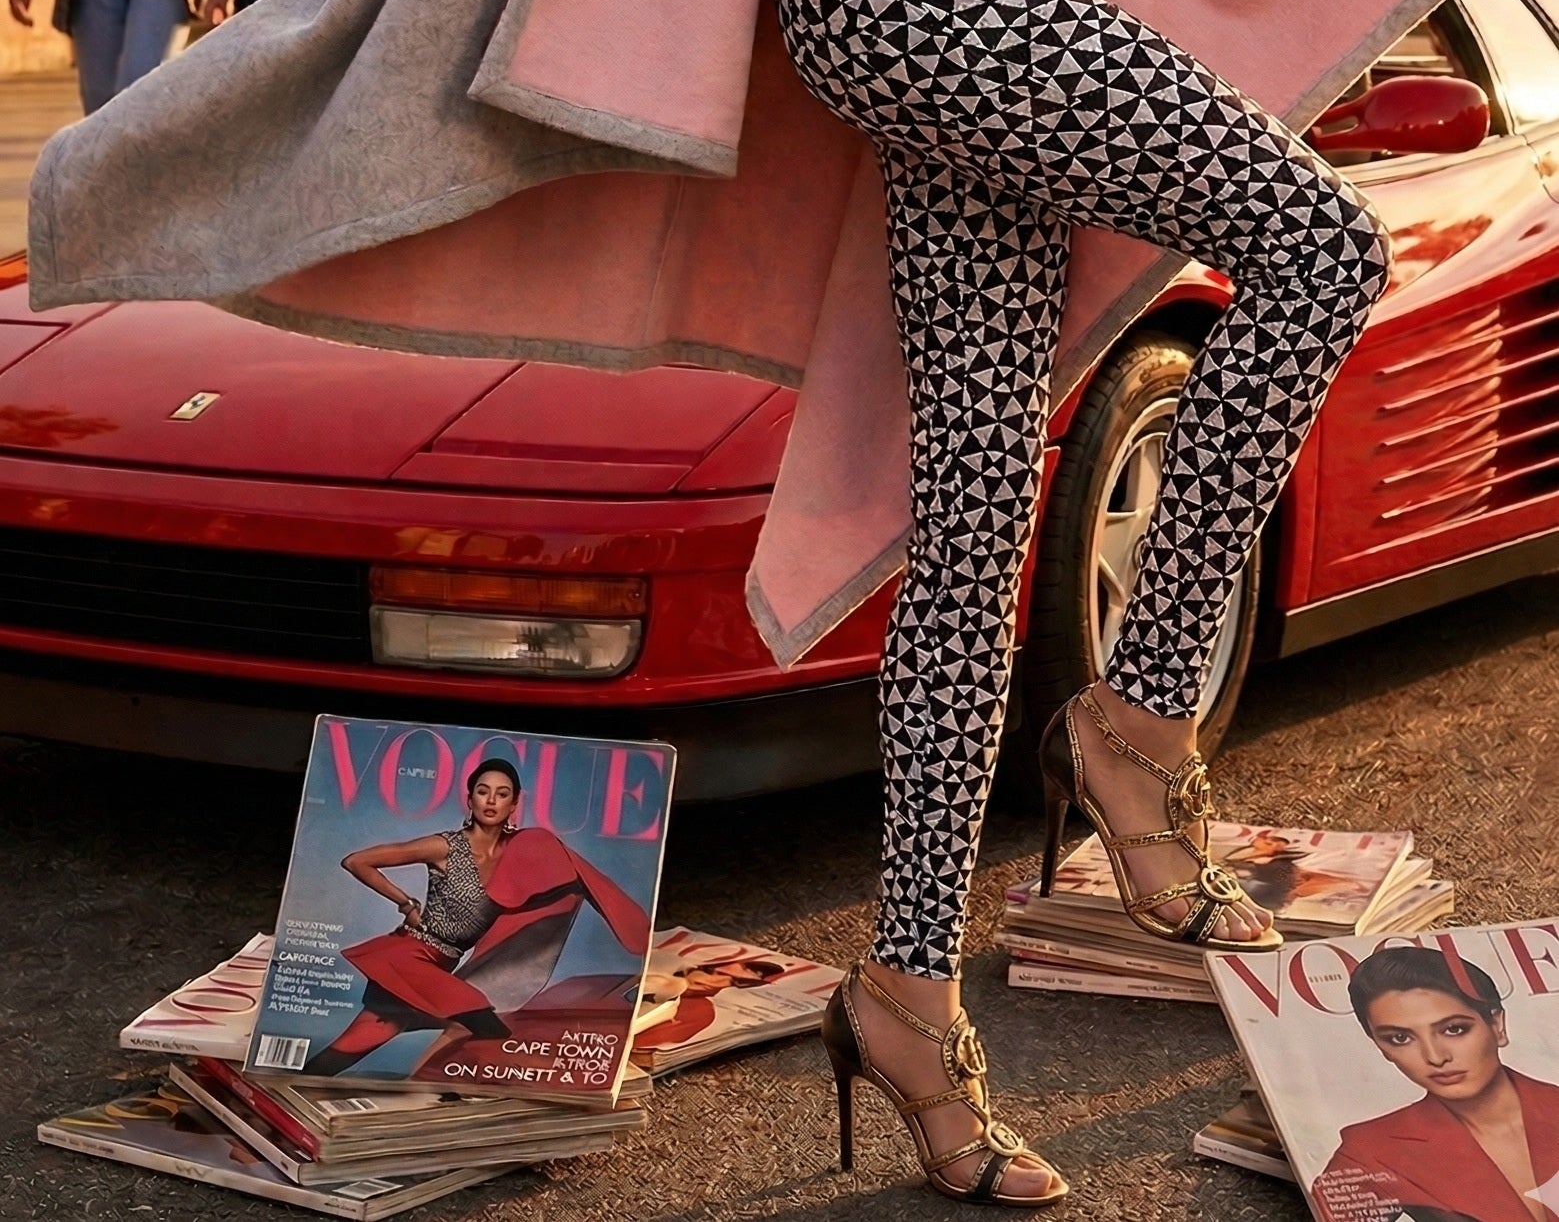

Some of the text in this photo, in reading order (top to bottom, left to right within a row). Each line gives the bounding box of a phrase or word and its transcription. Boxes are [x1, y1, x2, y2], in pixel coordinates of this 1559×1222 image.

[502, 1040, 614, 1059] CAPE TOWN
[444, 1063, 478, 1077] ON
[560, 1072, 574, 1084] &
[582, 1072, 607, 1085] TO
